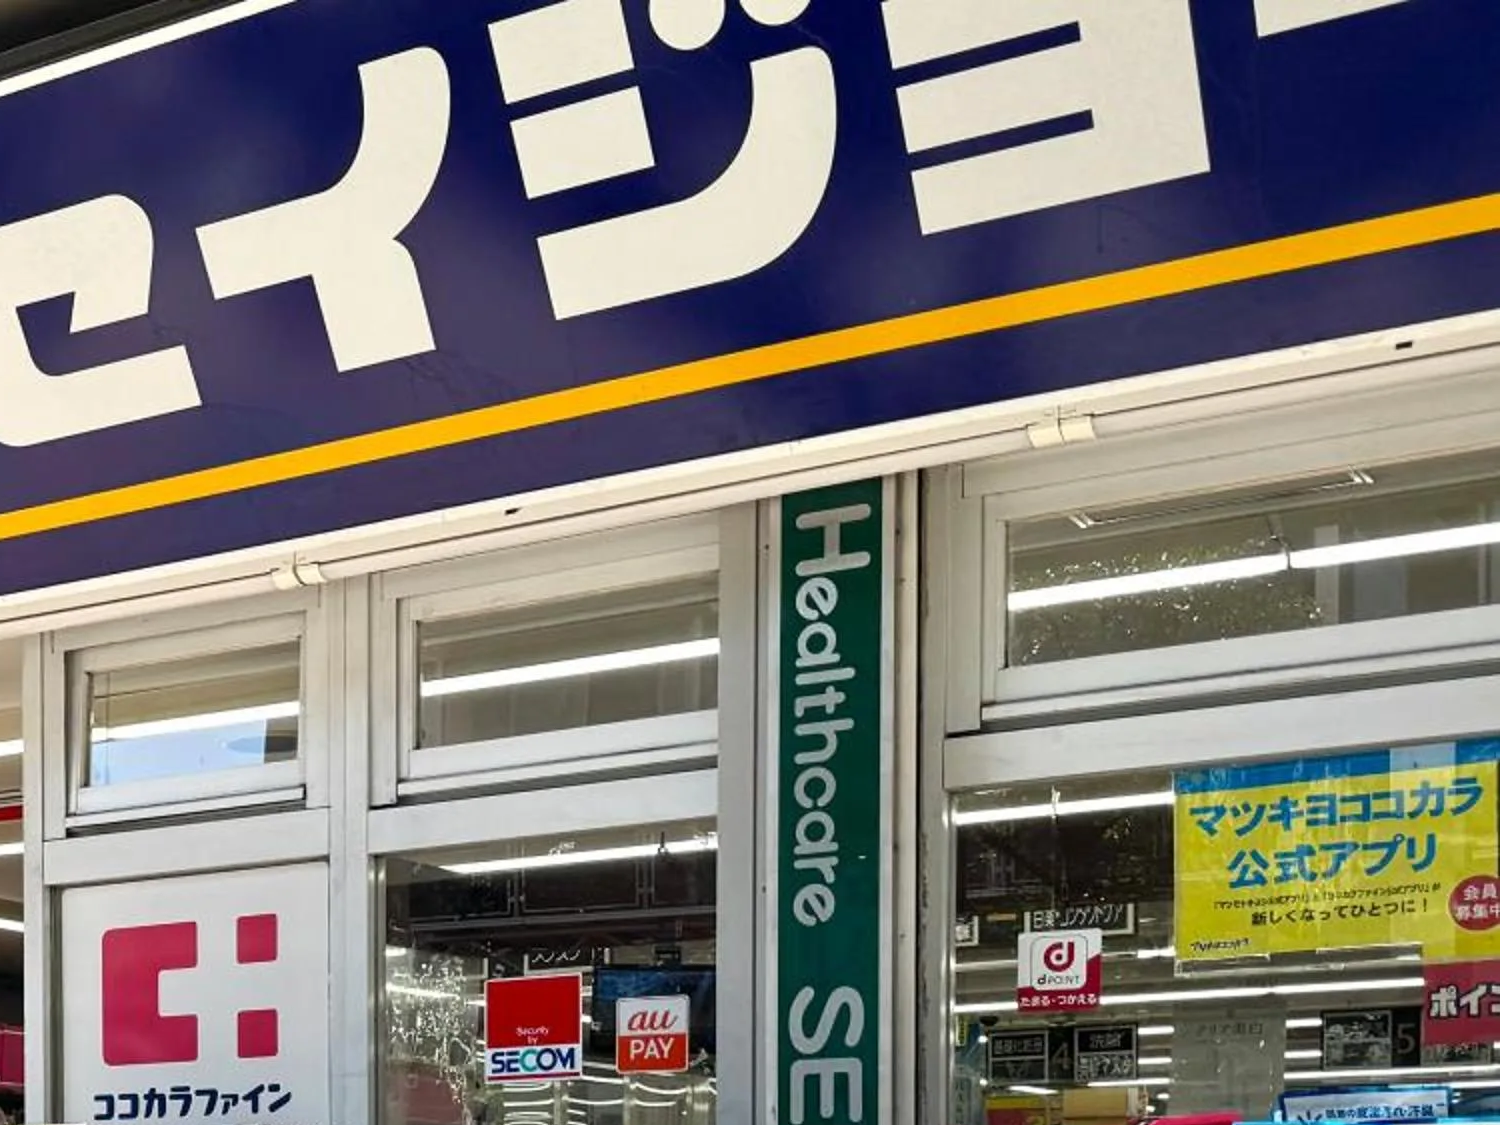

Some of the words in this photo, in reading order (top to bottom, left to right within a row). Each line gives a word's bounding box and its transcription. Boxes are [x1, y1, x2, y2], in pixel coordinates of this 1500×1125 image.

[792, 502, 872, 927] Healthcare
[1189, 777, 1484, 837] マツキヨココカラ
[1227, 833, 1438, 890] 公式アプリ
[516, 1026, 549, 1037] Security
[628, 1010, 677, 1031] au
[491, 1048, 575, 1073] SECOM
[630, 1037, 675, 1060] PAY
[93, 1082, 292, 1121] ココカラファイン
